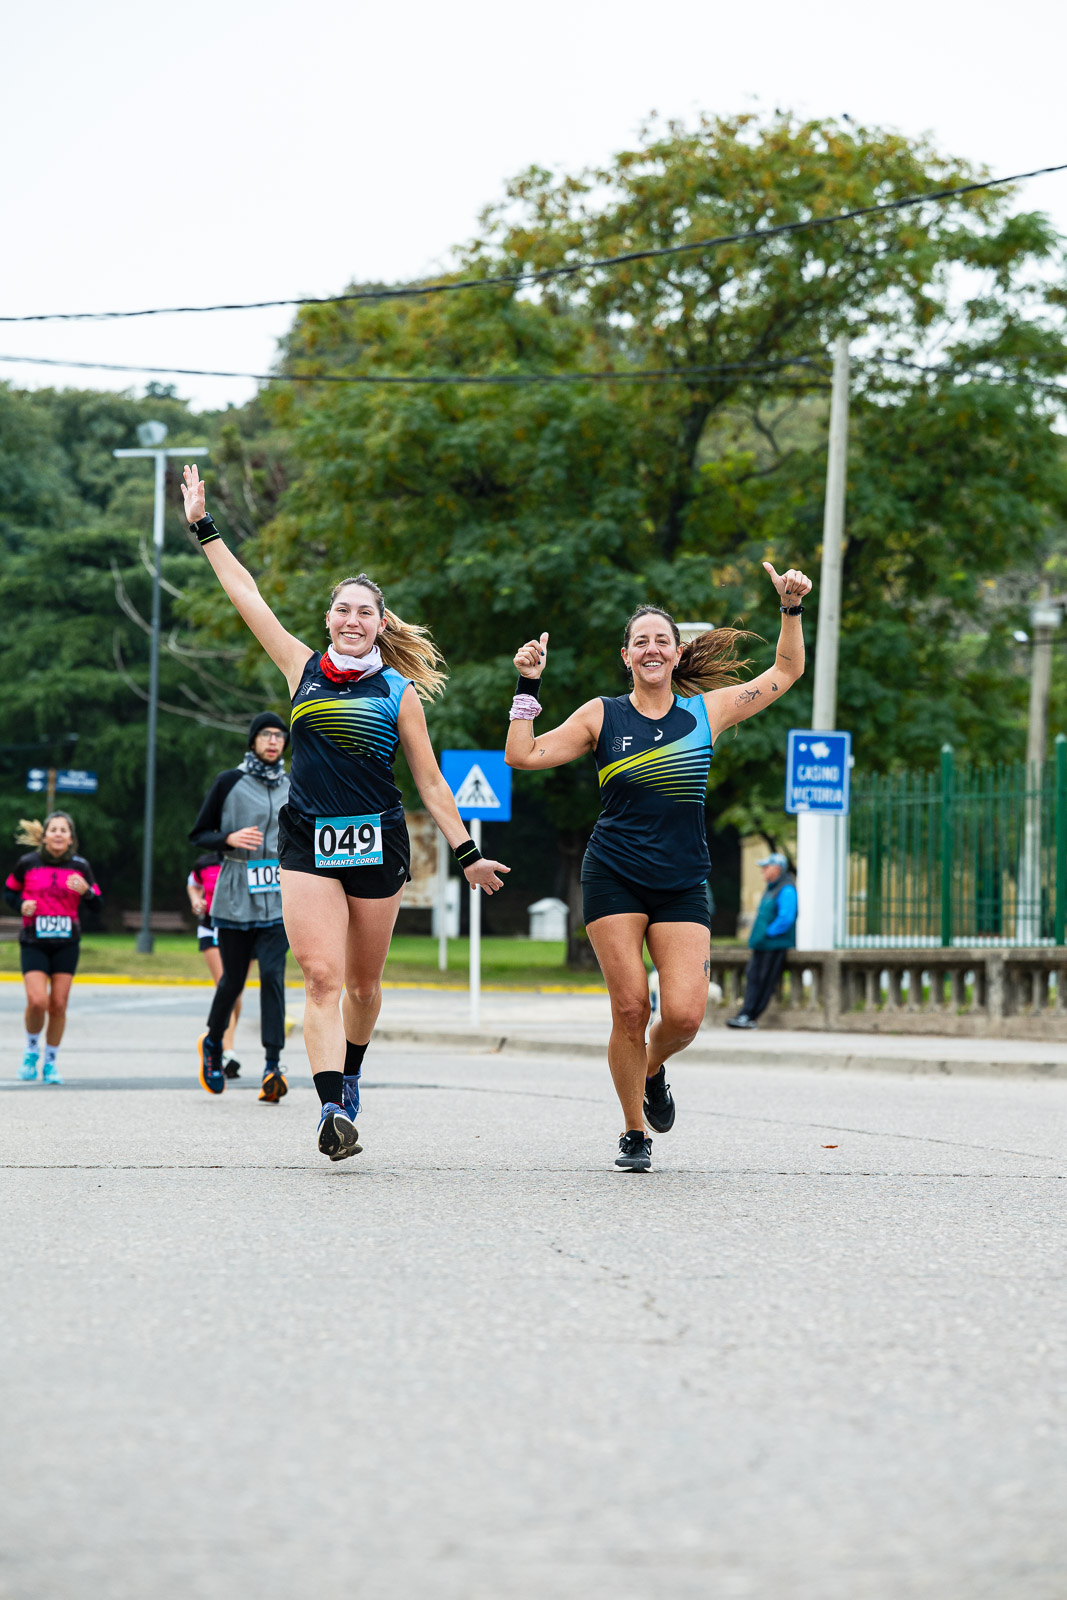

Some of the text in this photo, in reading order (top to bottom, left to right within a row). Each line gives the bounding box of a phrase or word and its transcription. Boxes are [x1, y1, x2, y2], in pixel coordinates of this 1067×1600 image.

[612, 736, 633, 752] SF
[318, 823, 376, 857] 049
[40, 915, 67, 932] 090
